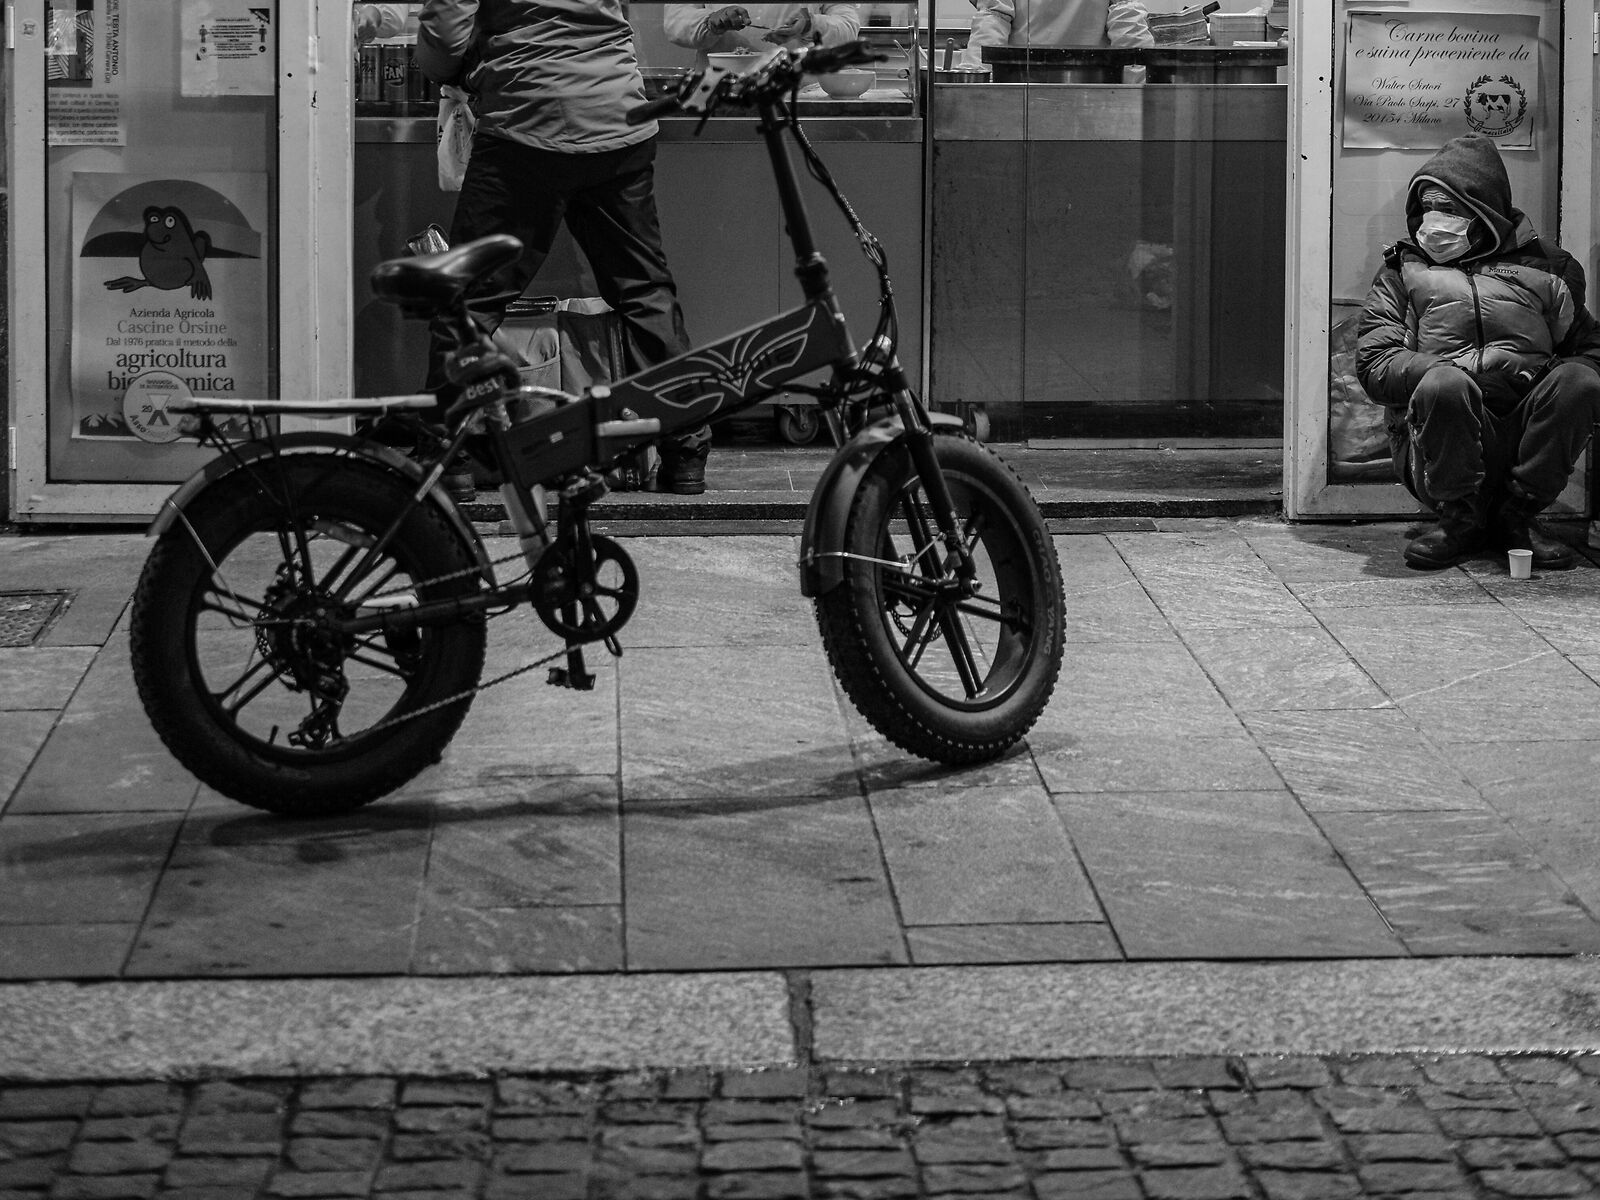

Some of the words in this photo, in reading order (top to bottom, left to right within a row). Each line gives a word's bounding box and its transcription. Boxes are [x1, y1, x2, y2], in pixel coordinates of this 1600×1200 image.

[1384, 18, 1444, 42] Carne
[1448, 26, 1500, 43] bovina
[1355, 48, 1365, 58] e
[1367, 46, 1410, 58] suina
[1409, 46, 1506, 66] proveniente
[1508, 44, 1530, 60] da
[1372, 76, 1406, 90] Walter
[1353, 94, 1374, 106] Via
[1376, 95, 1406, 106] Paolo
[1444, 97, 1460, 108] 27
[1404, 112, 1442, 124] Milano
[1488, 267, 1519, 276] Marmot
[130, 308, 171, 318] Azienda
[174, 308, 215, 321] Agricola
[117, 320, 174, 334] Cascine
[179, 320, 227, 334] Orsine
[217, 338, 238, 348] della
[116, 348, 226, 374] agricoltura
